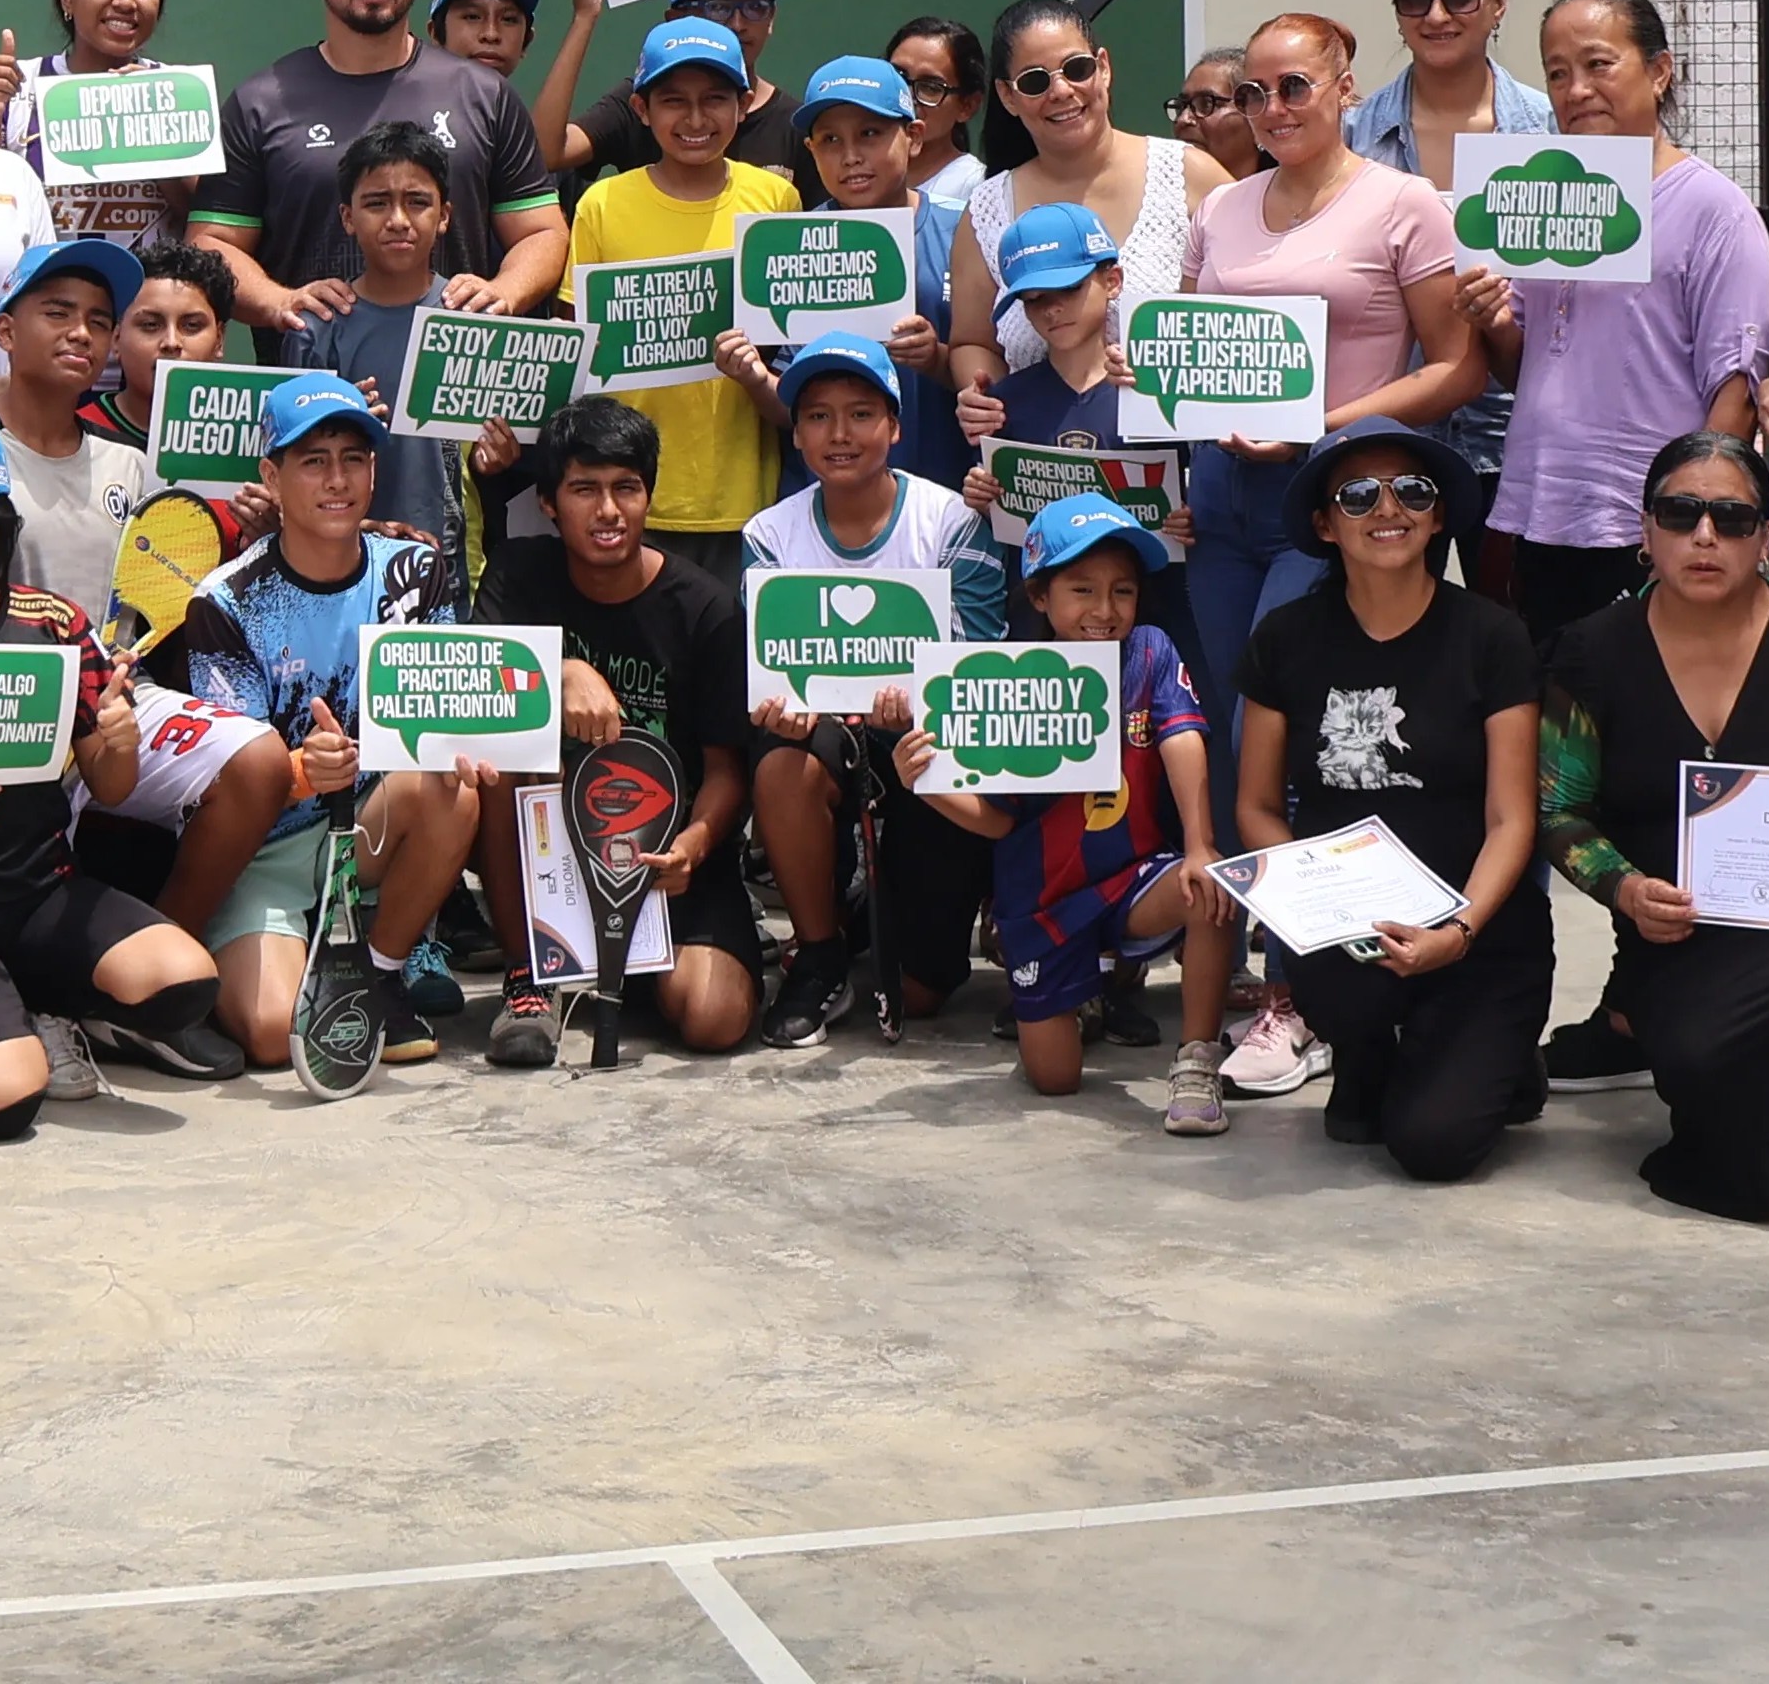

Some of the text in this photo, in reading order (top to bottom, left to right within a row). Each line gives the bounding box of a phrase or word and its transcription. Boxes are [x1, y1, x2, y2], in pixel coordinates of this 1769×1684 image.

[79, 81, 176, 116] DEPORTE ES
[49, 110, 210, 153] SALUD Y BIENESTAR
[1486, 180, 1618, 217] DISFRUTO MUCHO
[801, 221, 839, 252] AQUÍ
[1497, 216, 1603, 252] VERTE CRECER
[766, 250, 877, 279] APRENDEMOS
[615, 265, 714, 298] ME ATREVÍ A
[770, 274, 874, 305] CON ALEGRÍA
[607, 289, 718, 322] INTENTARLO Y
[636, 317, 691, 343] LO VOY
[1158, 312, 1285, 340] ME ENCANTA
[423, 322, 580, 363] ESTOY DANDO
[623, 337, 707, 367] LOGRANDO
[1130, 340, 1306, 369] VERTE DISFRUTAR
[442, 356, 549, 392] MI MEJOR
[1158, 369, 1282, 396] Y APRENDER
[189, 386, 251, 420] CADA
[432, 386, 545, 421] ESFUERZO
[161, 420, 234, 455] JUEGO
[1017, 458, 1095, 482] APRENDER
[1014, 476, 1079, 498] FRONTÓN
[820, 587, 828, 627] I
[380, 642, 503, 666] ORGULLOSO DE
[764, 637, 932, 665] PALETA FRONTO
[398, 668, 491, 691] PRACTICAR
[952, 678, 1084, 712] ENTRENO Y
[373, 690, 515, 718] PALETA FRONTÓN
[942, 713, 1092, 747] ME DIVIERTO
[564, 853, 577, 906] DIPLOMA
[1296, 864, 1345, 879] DIPLOMA
